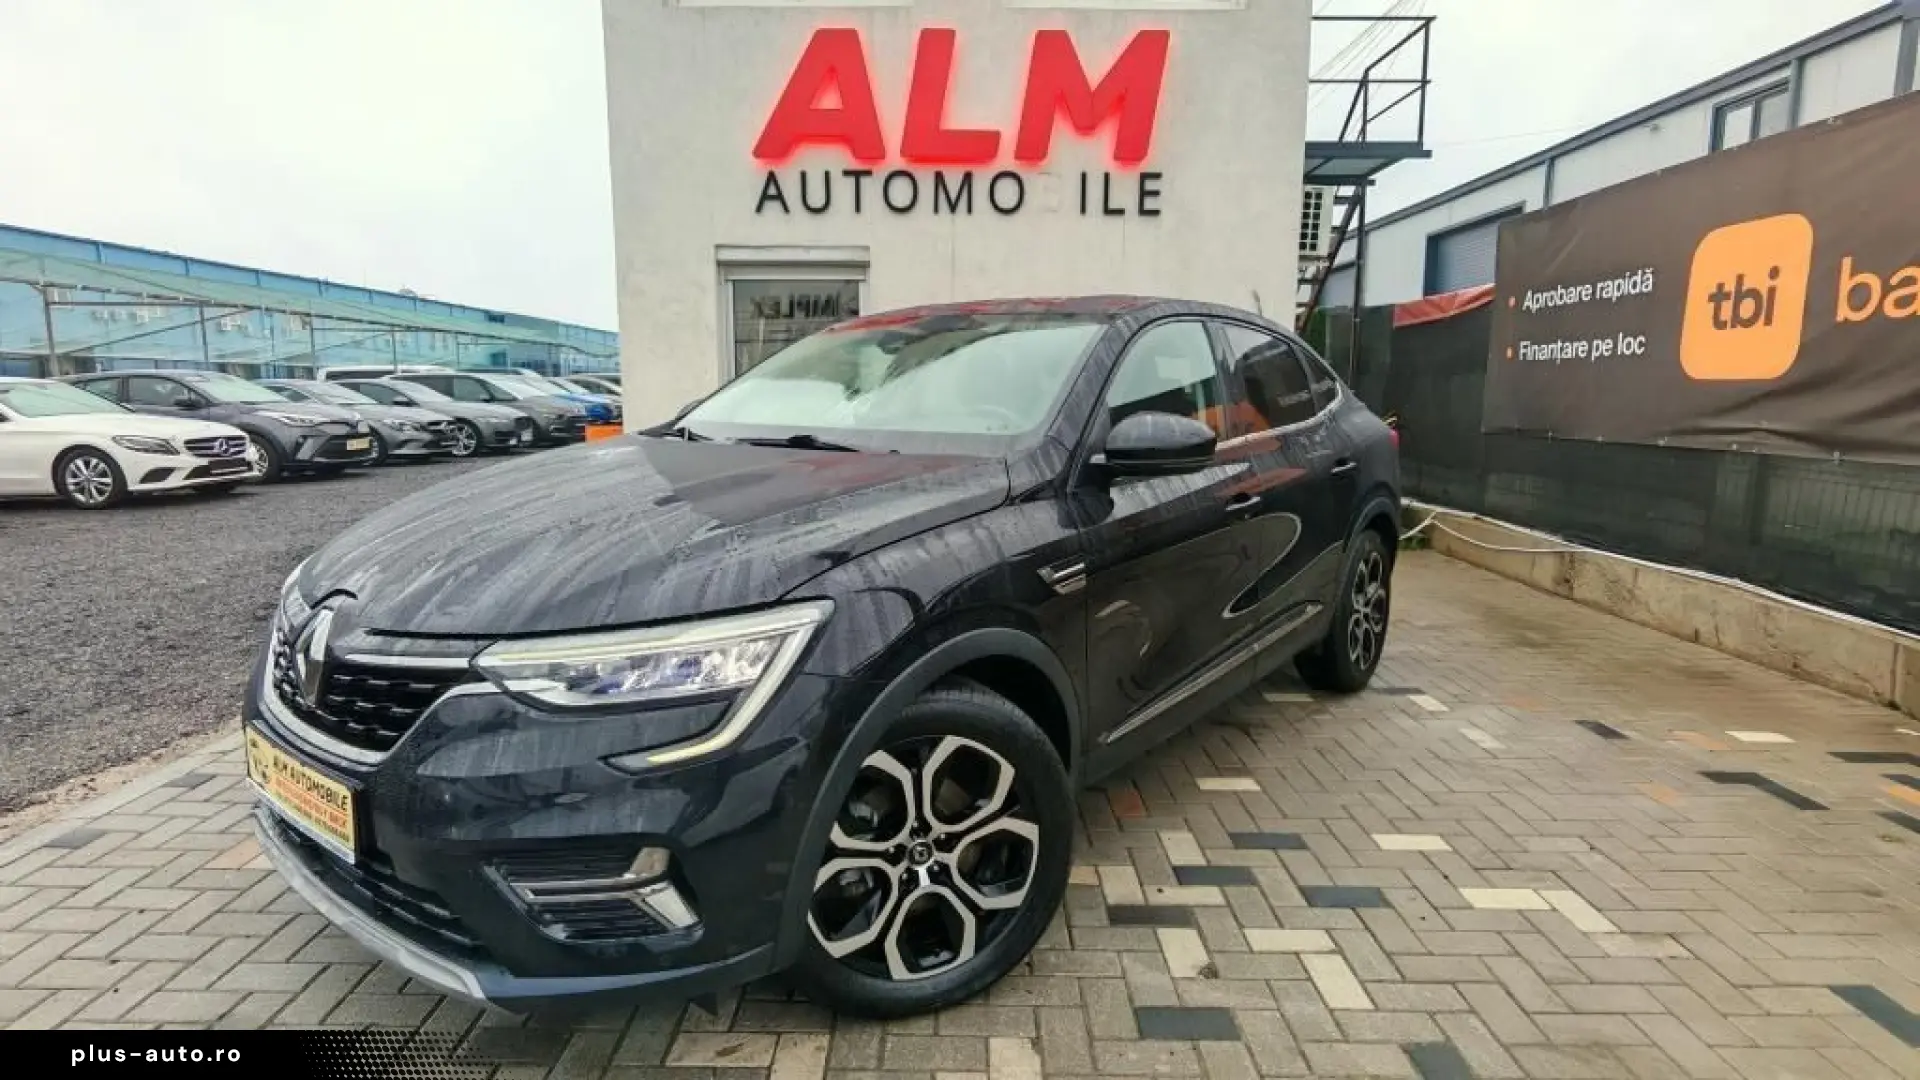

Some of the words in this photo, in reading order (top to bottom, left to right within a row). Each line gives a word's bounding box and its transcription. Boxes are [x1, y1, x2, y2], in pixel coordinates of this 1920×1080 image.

[752, 27, 1171, 163] ALM
[755, 170, 1163, 215] AUTOMOILE
[1522, 284, 1593, 313] Aprobare
[1595, 267, 1654, 303] rapidă
[1707, 265, 1780, 331] tbi
[1518, 338, 1589, 364] Finanțare
[1591, 338, 1614, 363] pe
[1617, 331, 1646, 356] loc
